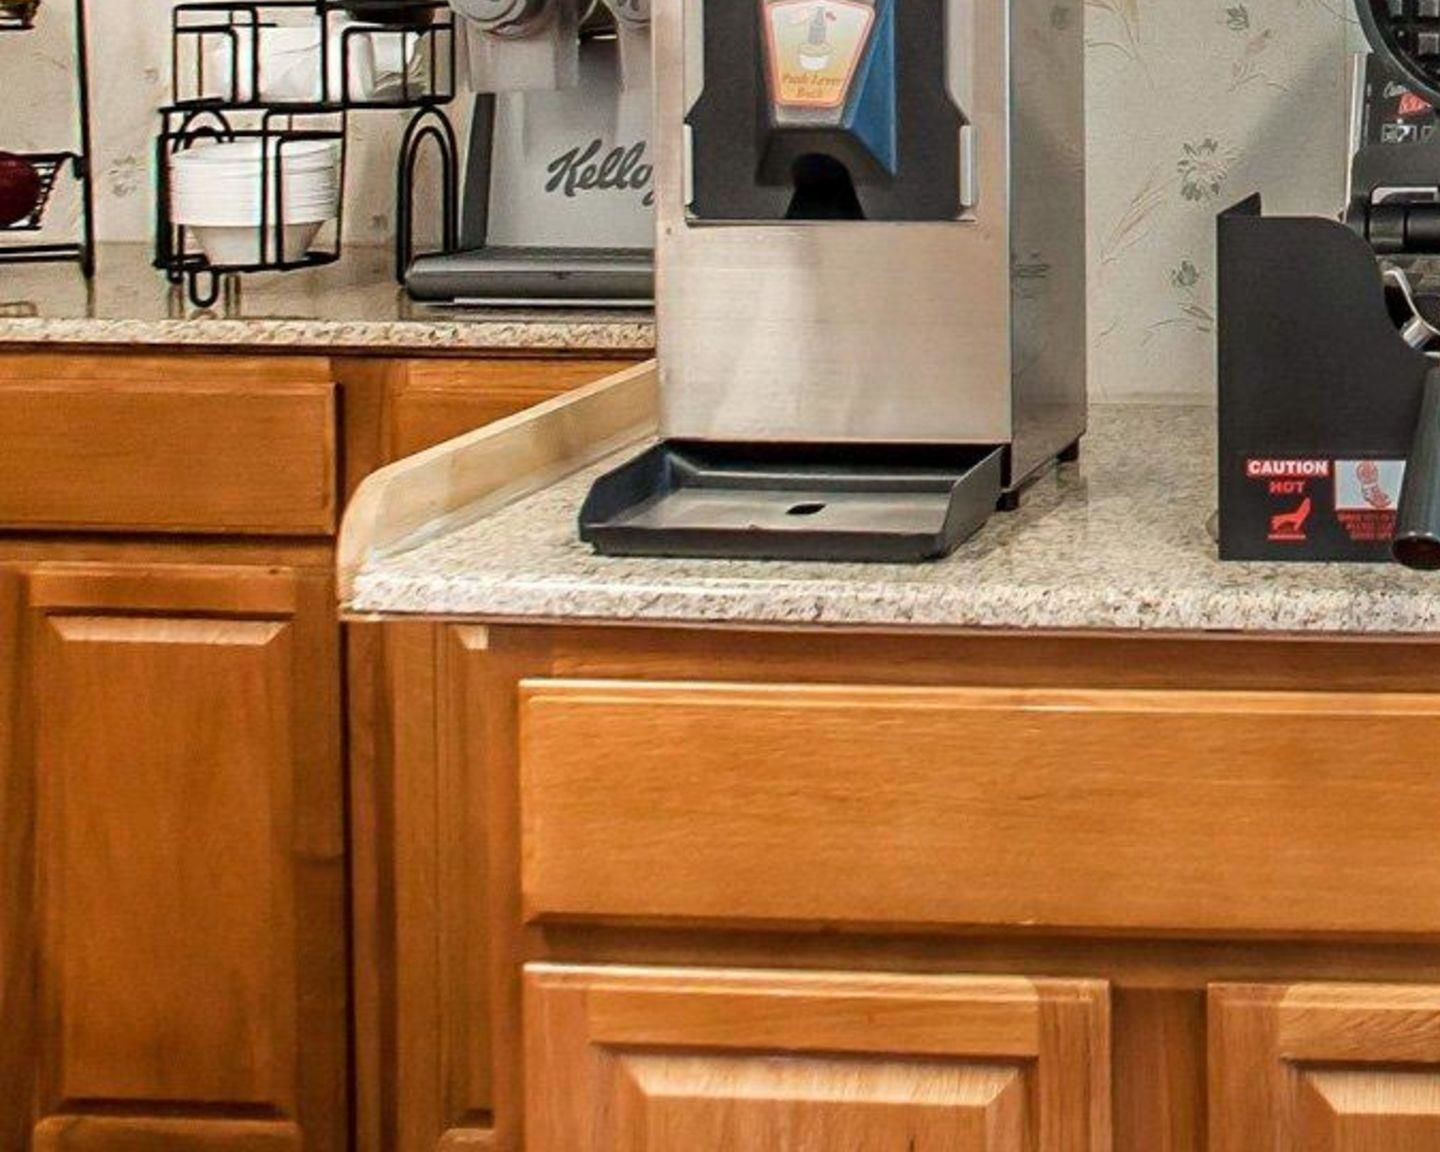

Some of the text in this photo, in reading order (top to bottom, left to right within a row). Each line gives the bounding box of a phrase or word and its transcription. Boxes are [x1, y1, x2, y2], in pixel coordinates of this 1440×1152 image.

[545, 138, 654, 206] Kello
[1248, 460, 1329, 475] CAUTION
[1269, 481, 1305, 493] HOT
